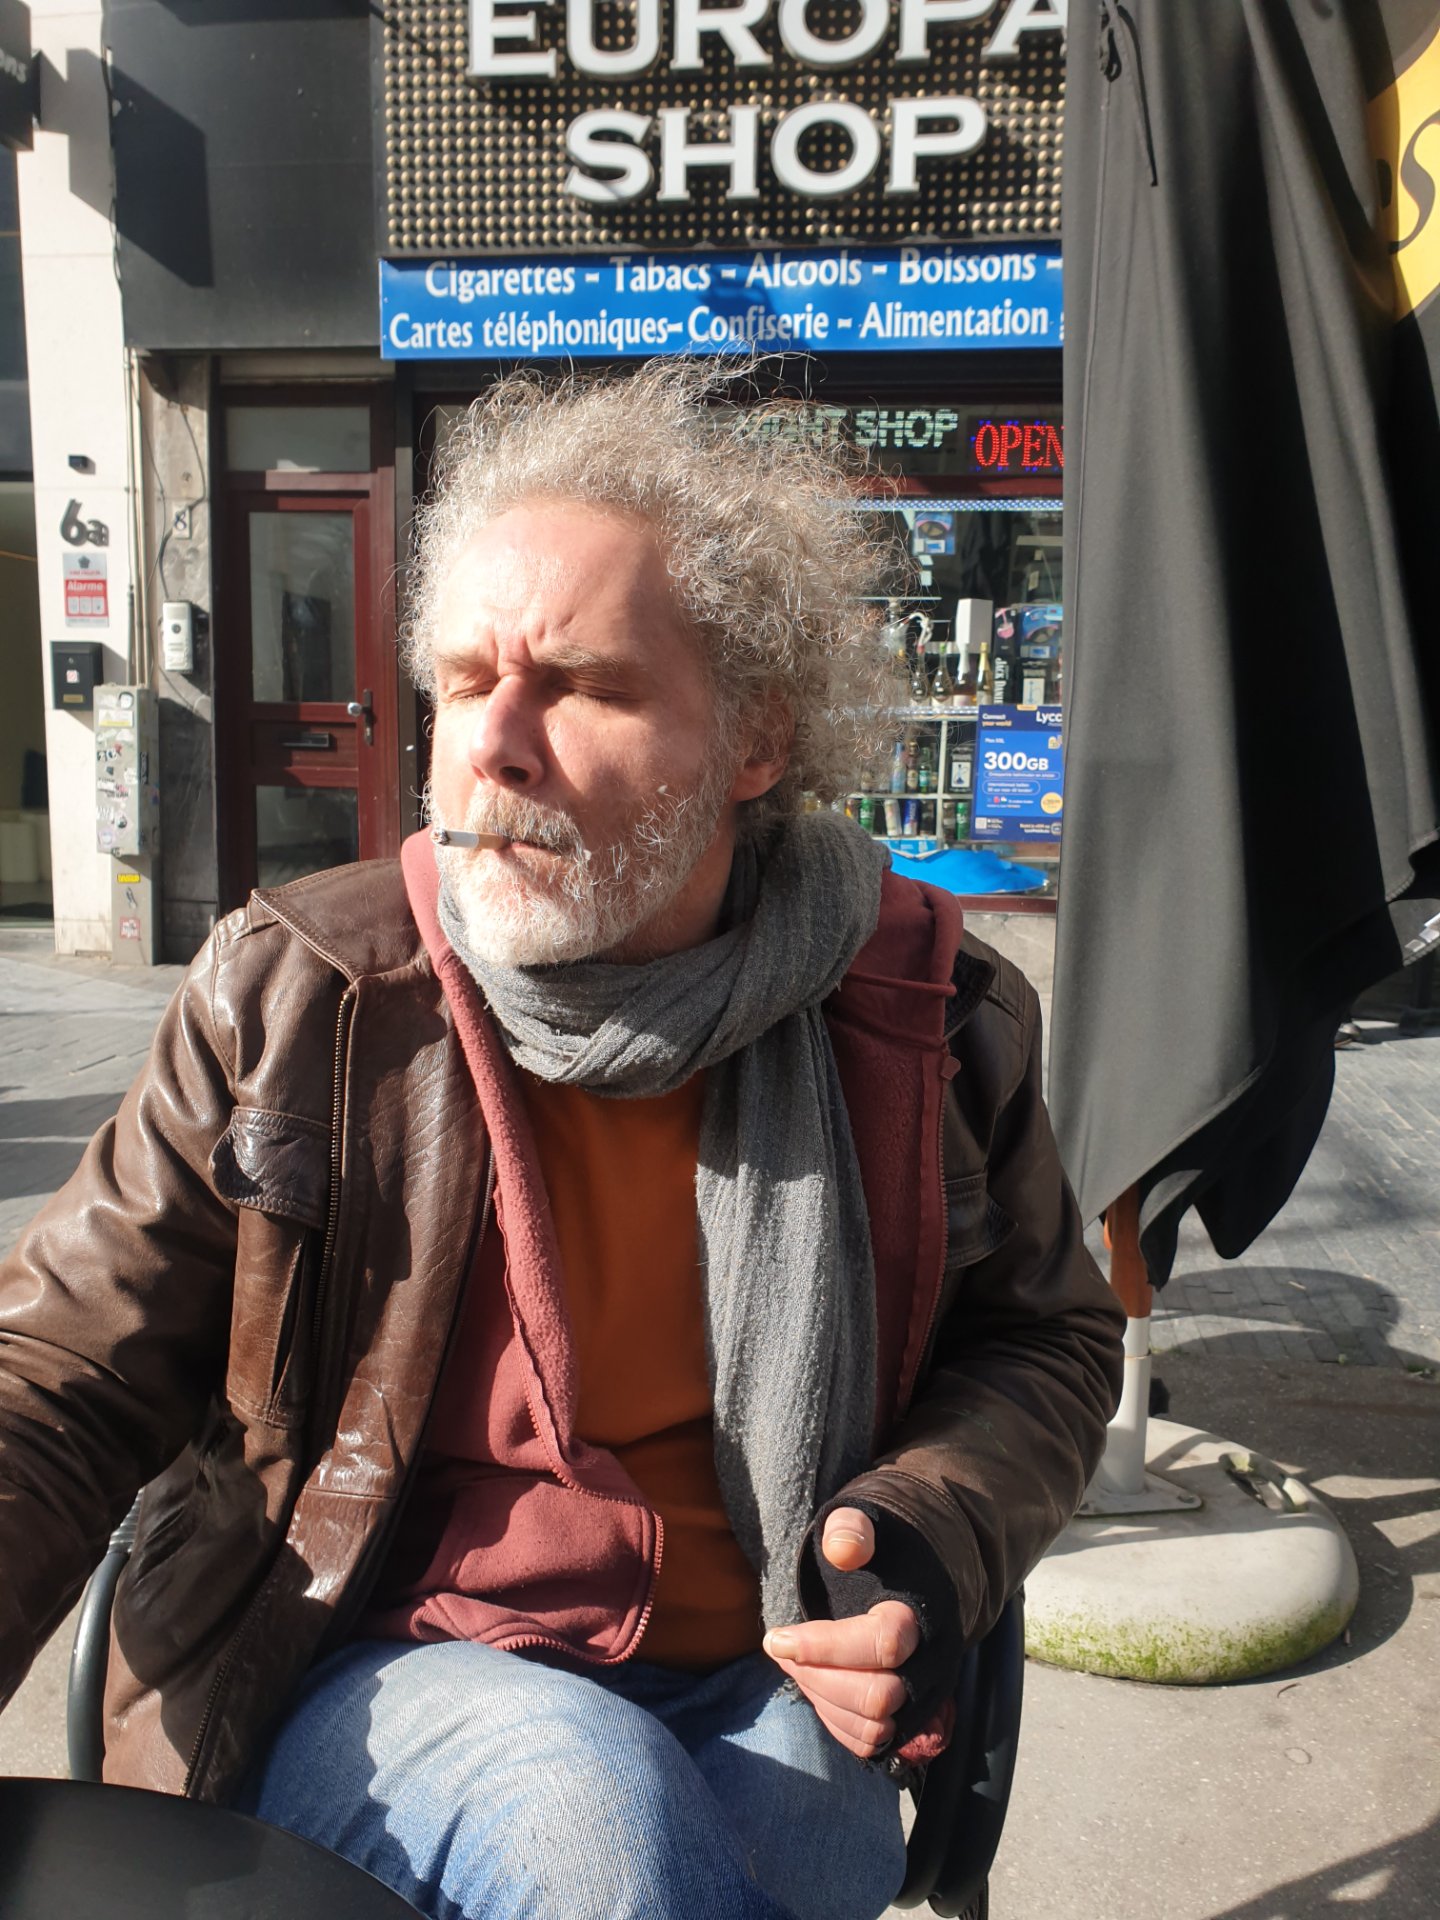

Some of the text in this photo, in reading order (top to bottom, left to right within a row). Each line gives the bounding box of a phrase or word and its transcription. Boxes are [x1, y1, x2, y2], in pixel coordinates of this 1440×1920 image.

[566, 97, 987, 201] SHOP
[425, 260, 575, 303] Cigarettes
[609, 255, 711, 292] Tabacs
[745, 250, 862, 288] Alcools
[899, 246, 1036, 285] Boissons
[389, 312, 473, 349] Cartes
[687, 303, 829, 342] Confiserie
[859, 298, 1049, 338] Alimentation
[855, 408, 958, 448] SHOP
[975, 423, 1064, 468] OPEN
[59, 498, 109, 547] 6a
[67, 580, 104, 592] Alarme
[983, 751, 1049, 771] 300GB
